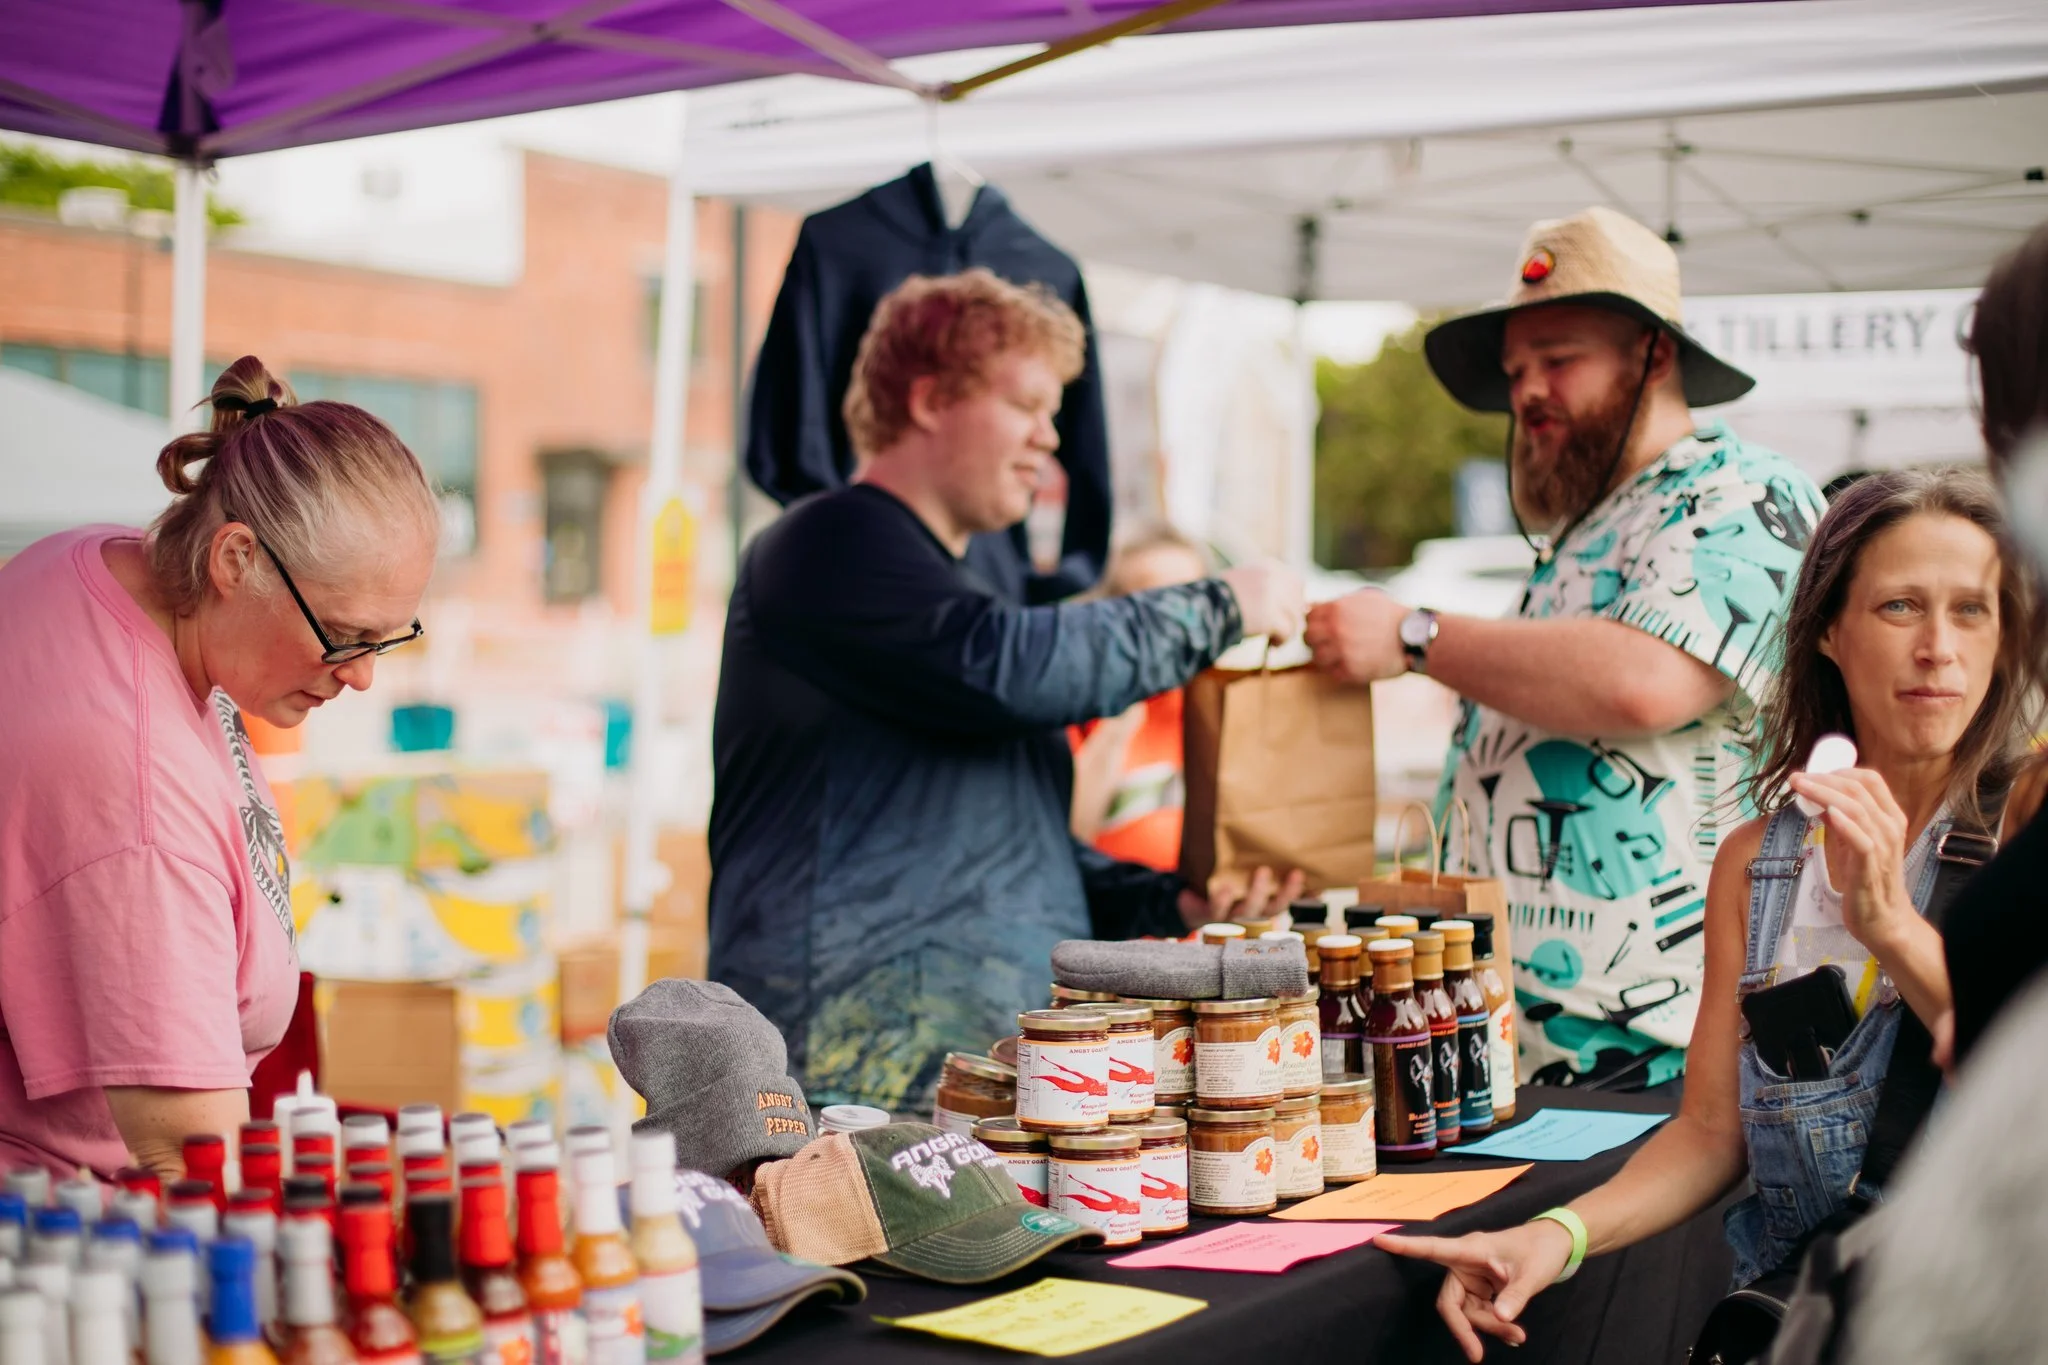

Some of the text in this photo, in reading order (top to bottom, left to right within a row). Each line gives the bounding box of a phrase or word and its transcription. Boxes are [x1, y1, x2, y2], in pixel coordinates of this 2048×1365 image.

[1688, 306, 1938, 354] TILLERY
[757, 1090, 793, 1111] ANGRY
[764, 1116, 809, 1137] PEPPER
